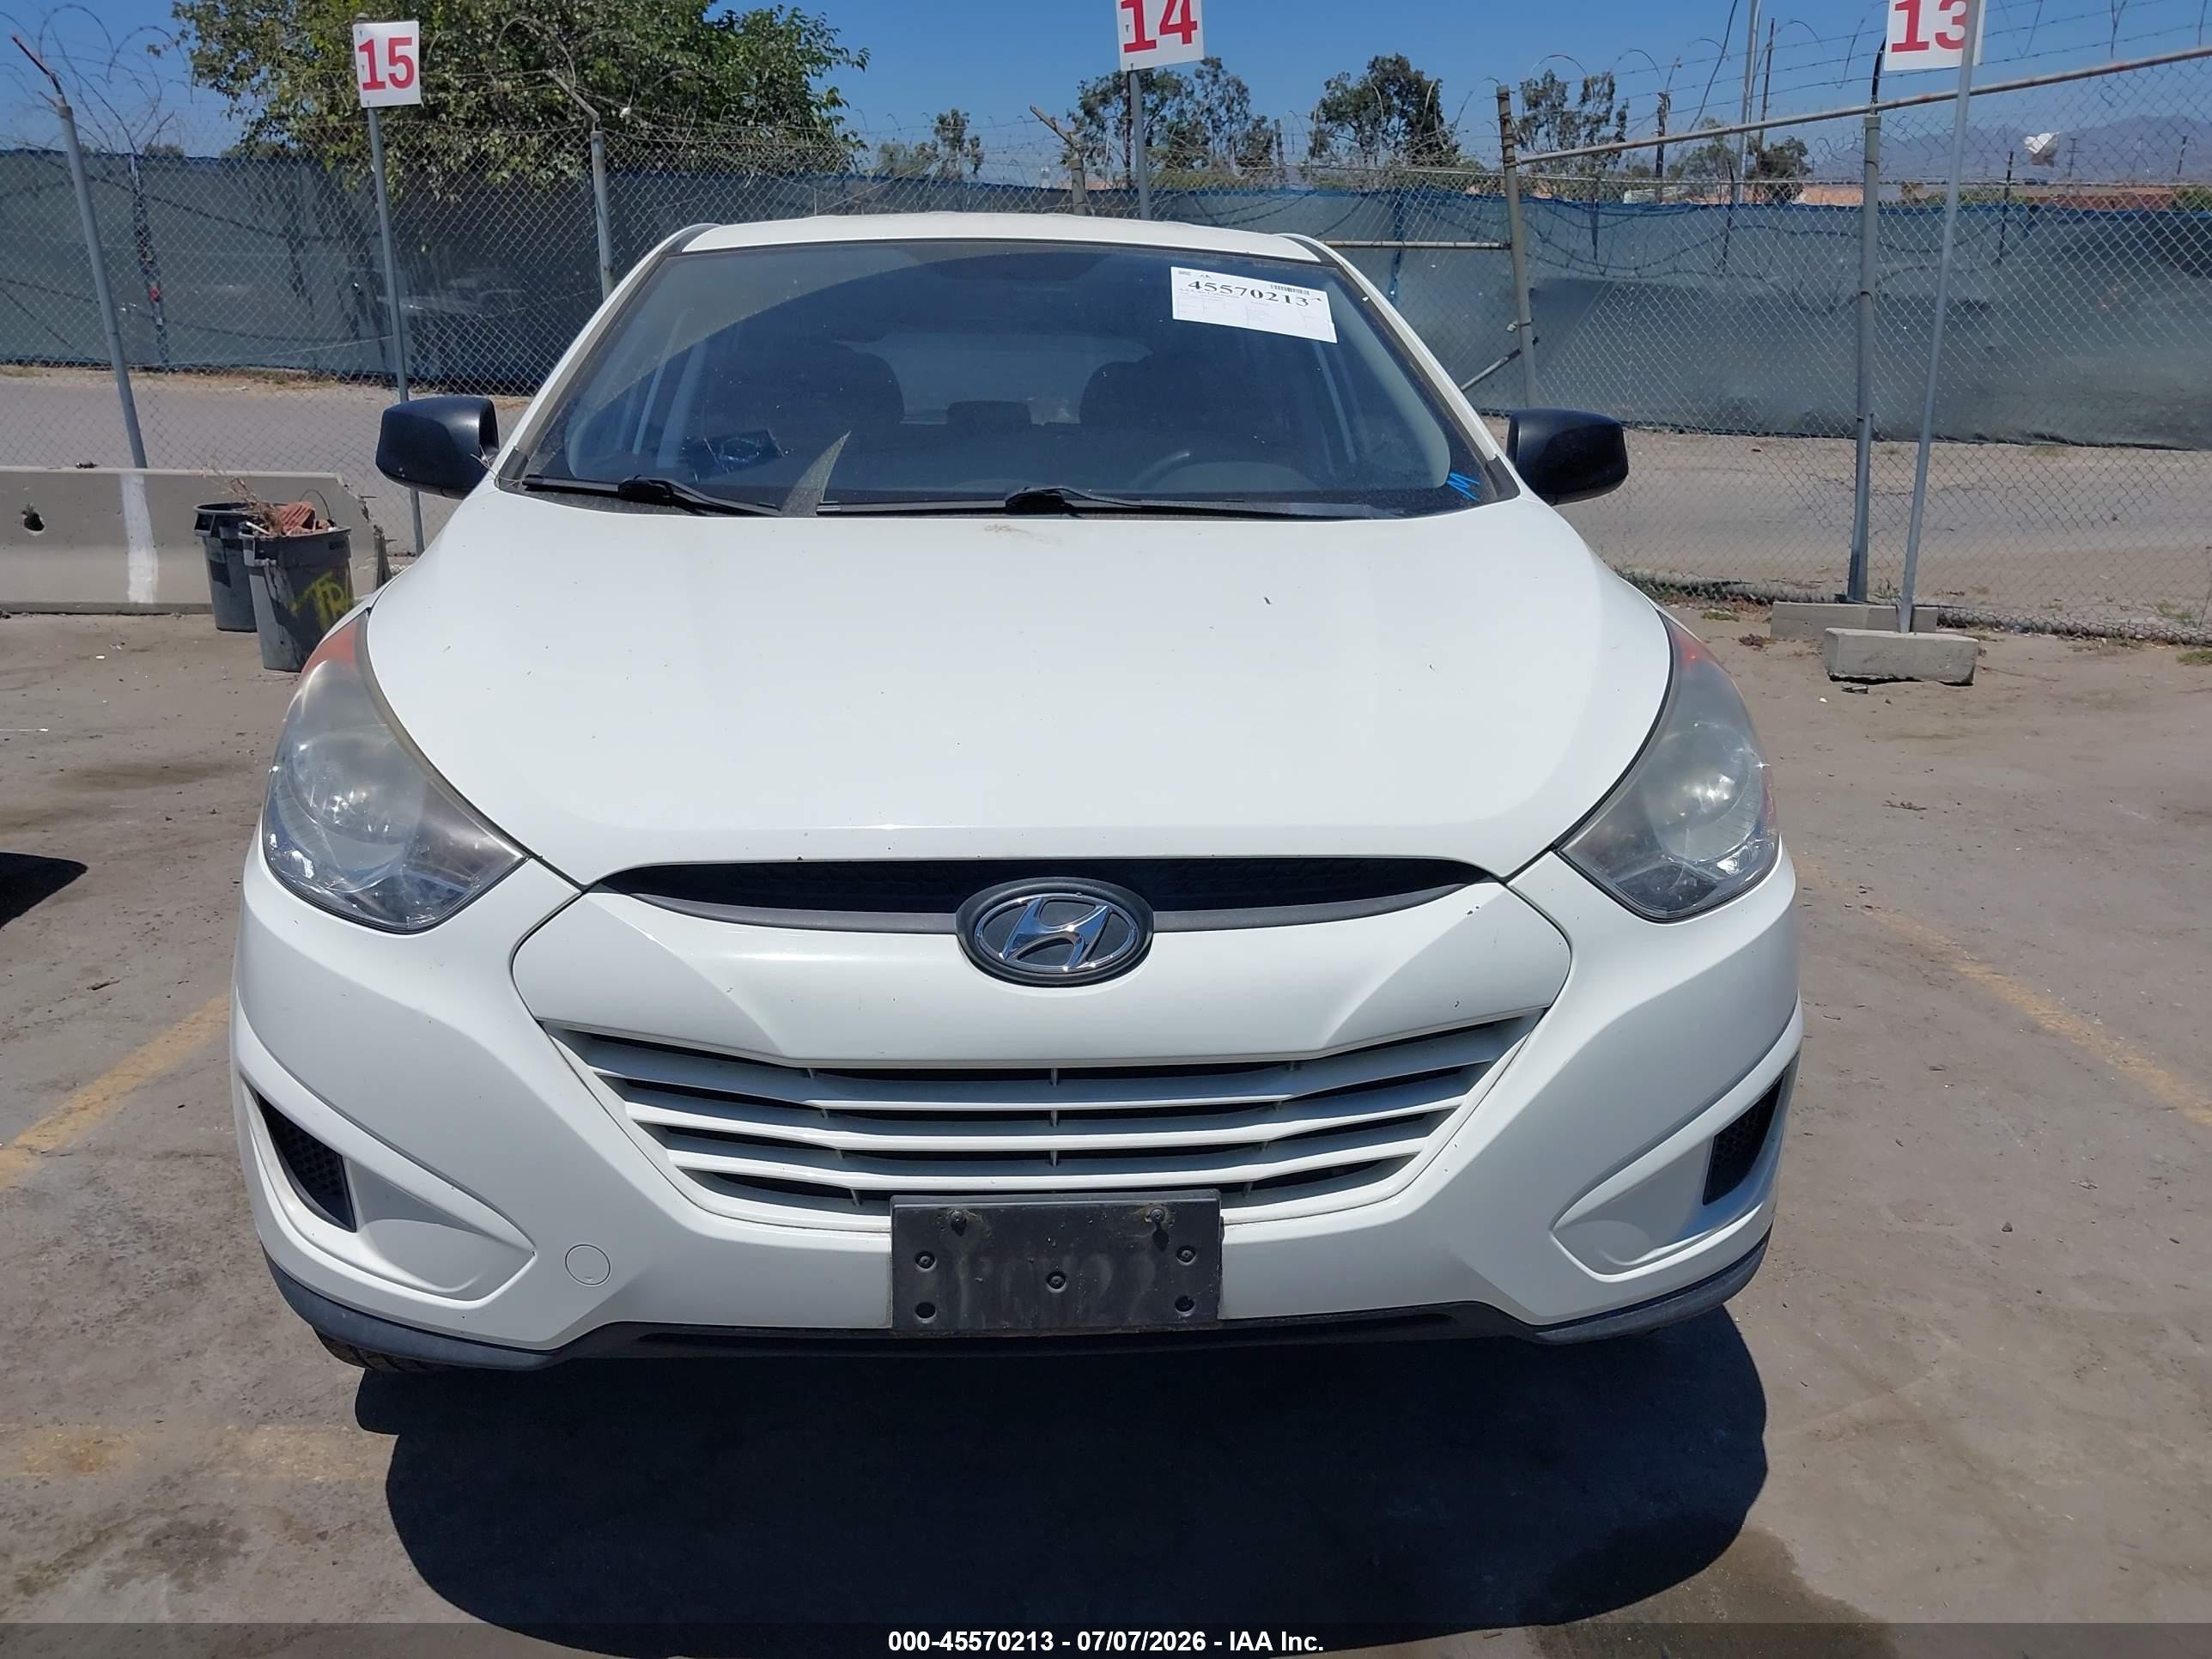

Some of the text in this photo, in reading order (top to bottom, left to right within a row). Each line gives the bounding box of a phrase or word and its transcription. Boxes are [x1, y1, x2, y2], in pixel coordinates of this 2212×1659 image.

[1120, 0, 1198, 53] 14
[1891, 0, 1967, 53] 13
[358, 36, 415, 91] 15
[1188, 280, 1310, 307] 45570213
